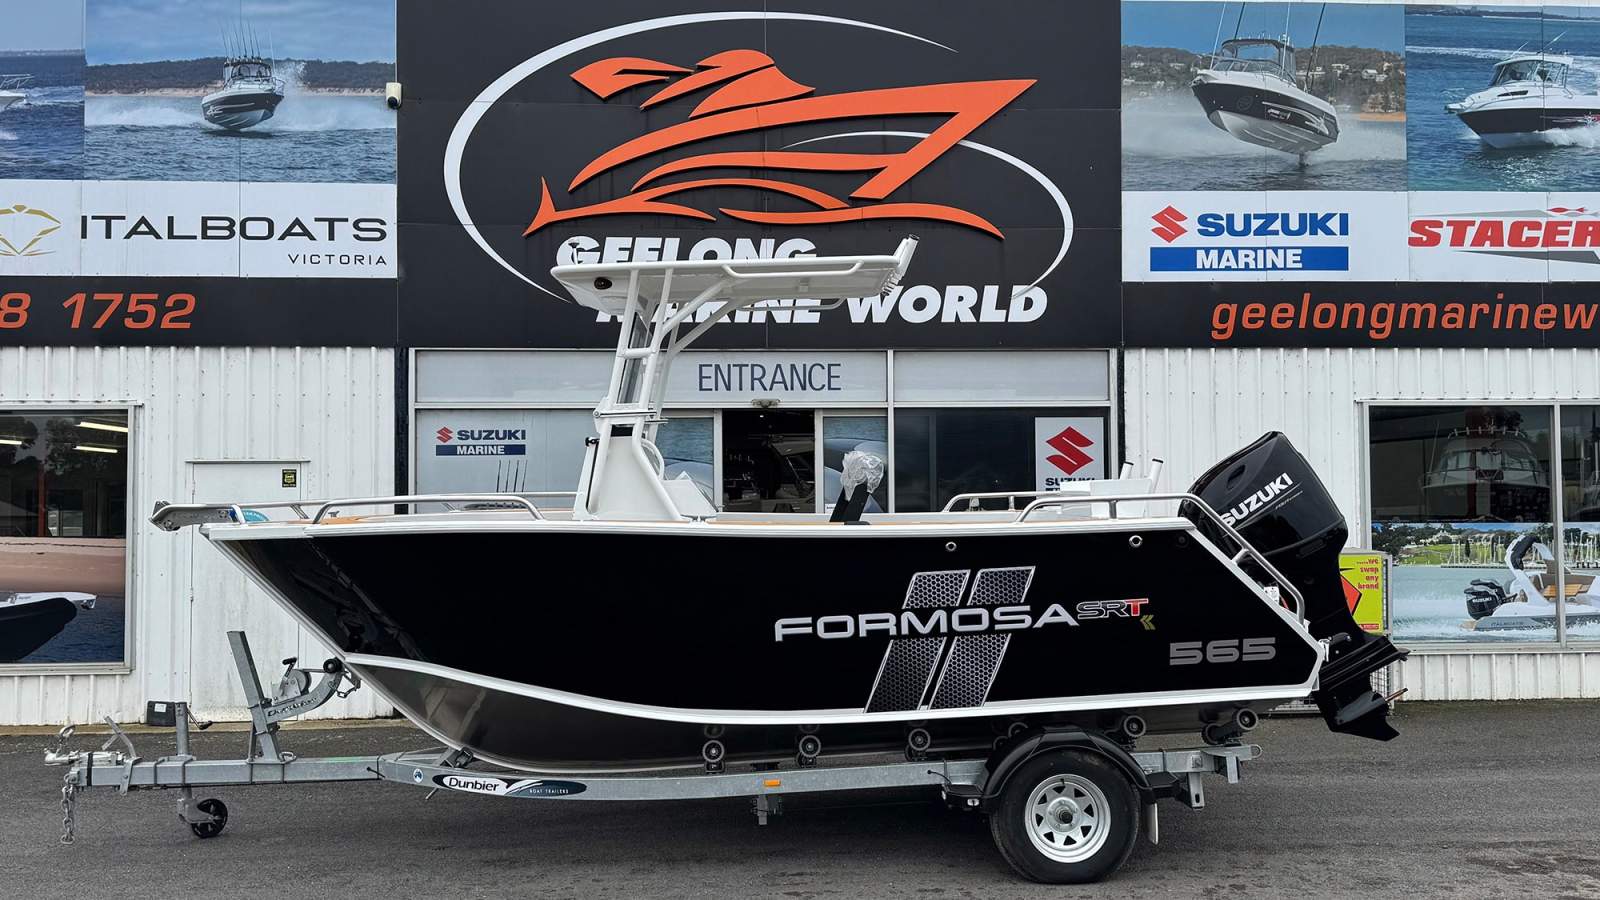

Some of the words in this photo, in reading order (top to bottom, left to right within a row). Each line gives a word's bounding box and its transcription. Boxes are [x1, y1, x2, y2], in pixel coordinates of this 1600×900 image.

[80, 215, 387, 242] ITALBOATS
[1197, 212, 1349, 237] SUZUKI
[1408, 219, 1600, 248] STACER
[288, 254, 387, 265] VICTORIA
[1196, 249, 1303, 268] MARINE
[0, 292, 31, 329] 8
[62, 292, 196, 329] 1752
[847, 285, 1048, 323] WORLD
[1211, 293, 1599, 341] geelongmarinew
[699, 362, 842, 392] ENTRANCE
[457, 429, 526, 441] SUZUKI
[457, 445, 505, 455] MARINE
[1220, 472, 1293, 527] SUZUKI
[774, 603, 1080, 642] FORMOSA
[1076, 597, 1149, 620] SRT
[1169, 637, 1276, 666] 565
[449, 777, 500, 791] Dunbier
